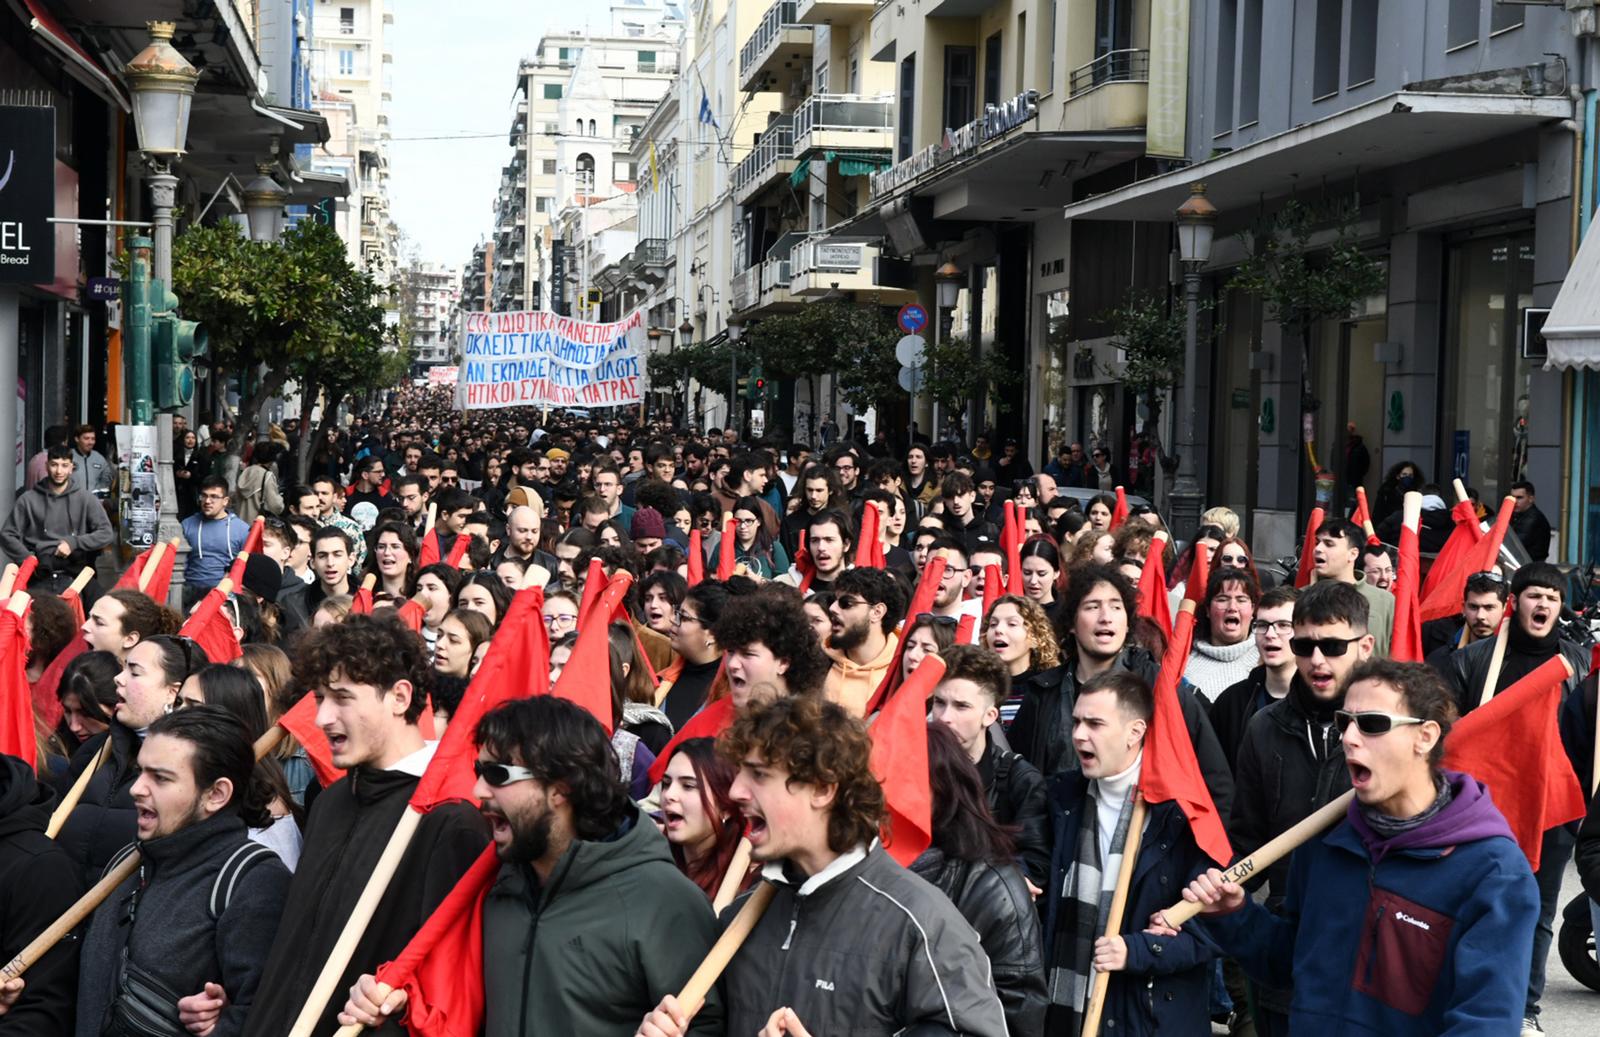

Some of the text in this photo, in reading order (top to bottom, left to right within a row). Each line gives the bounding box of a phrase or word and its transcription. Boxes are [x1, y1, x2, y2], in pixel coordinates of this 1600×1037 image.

[0, 221, 31, 250] EL
[0, 253, 30, 265] Bread
[466, 381, 517, 405] ΗΤΙΚΟΙ
[582, 376, 641, 404] ΠΑΤΡΑΣ
[1402, 914, 1430, 930] Columbia
[815, 979, 835, 991] FILA
